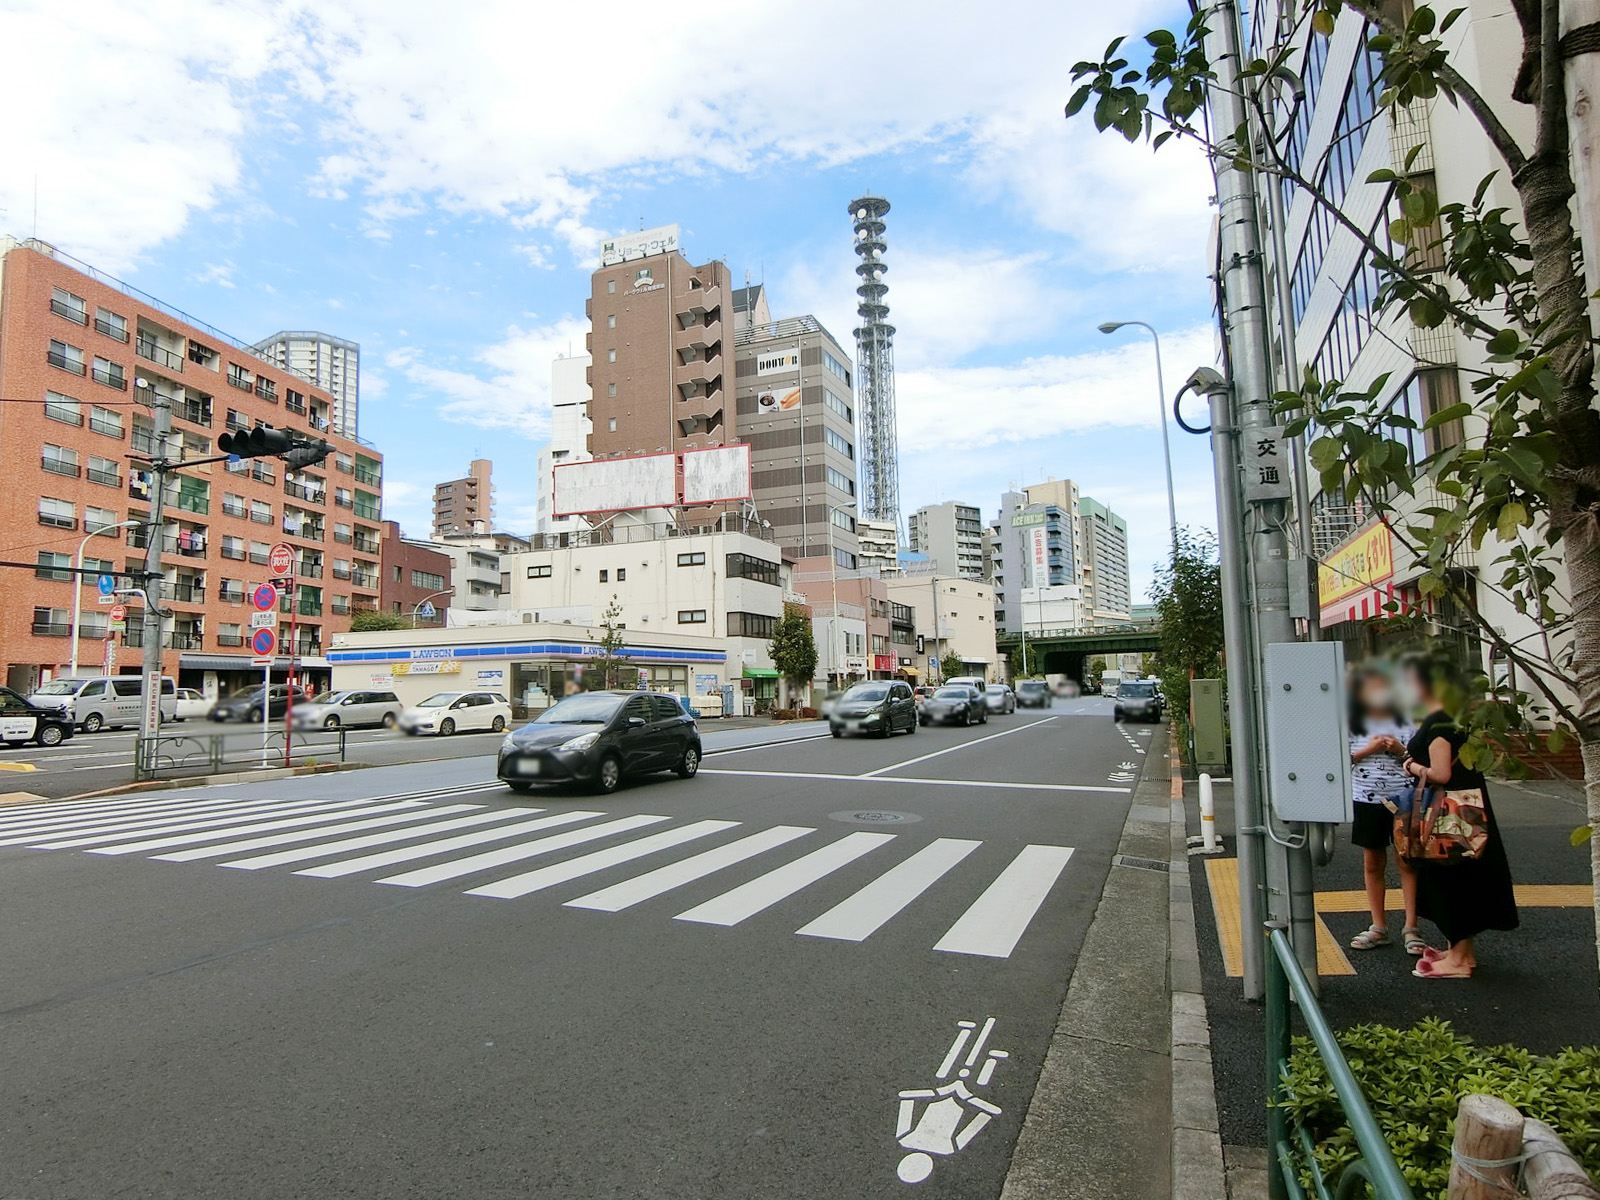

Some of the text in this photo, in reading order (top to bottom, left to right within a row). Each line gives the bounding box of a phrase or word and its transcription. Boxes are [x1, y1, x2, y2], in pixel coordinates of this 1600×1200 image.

[759, 355, 798, 371] DOUTOR
[1257, 438, 1280, 485] 交通
[412, 648, 452, 659] LAWSON
[583, 646, 610, 656] LAWS
